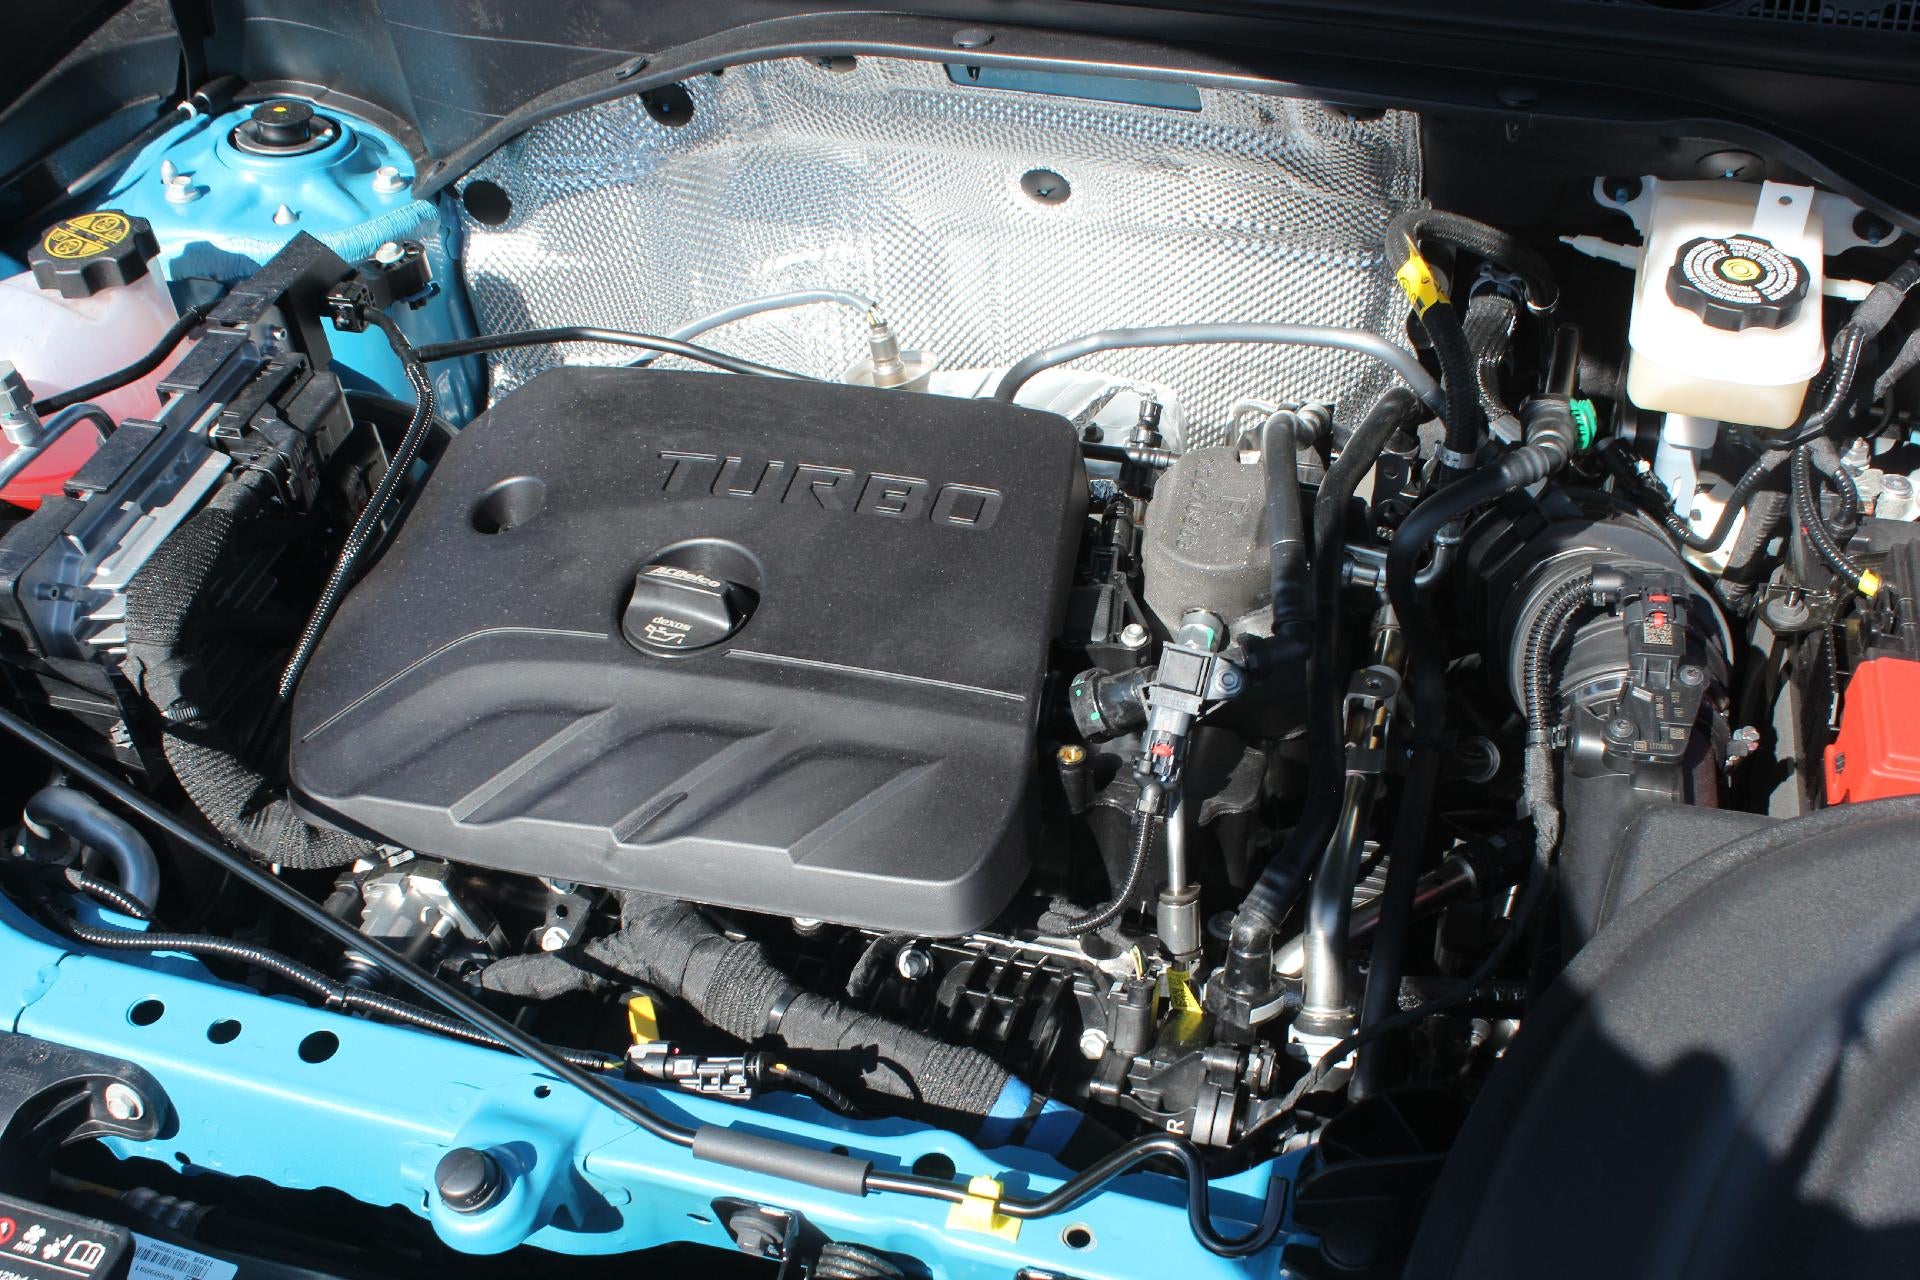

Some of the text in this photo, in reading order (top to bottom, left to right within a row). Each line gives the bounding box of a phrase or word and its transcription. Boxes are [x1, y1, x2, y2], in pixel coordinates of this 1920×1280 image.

[658, 450, 1003, 531] TURBO
[646, 566, 721, 587] ACDelco
[652, 617, 692, 631] dexos
[1166, 1119, 1185, 1134] R
[13, 1241, 37, 1254] AUTO
